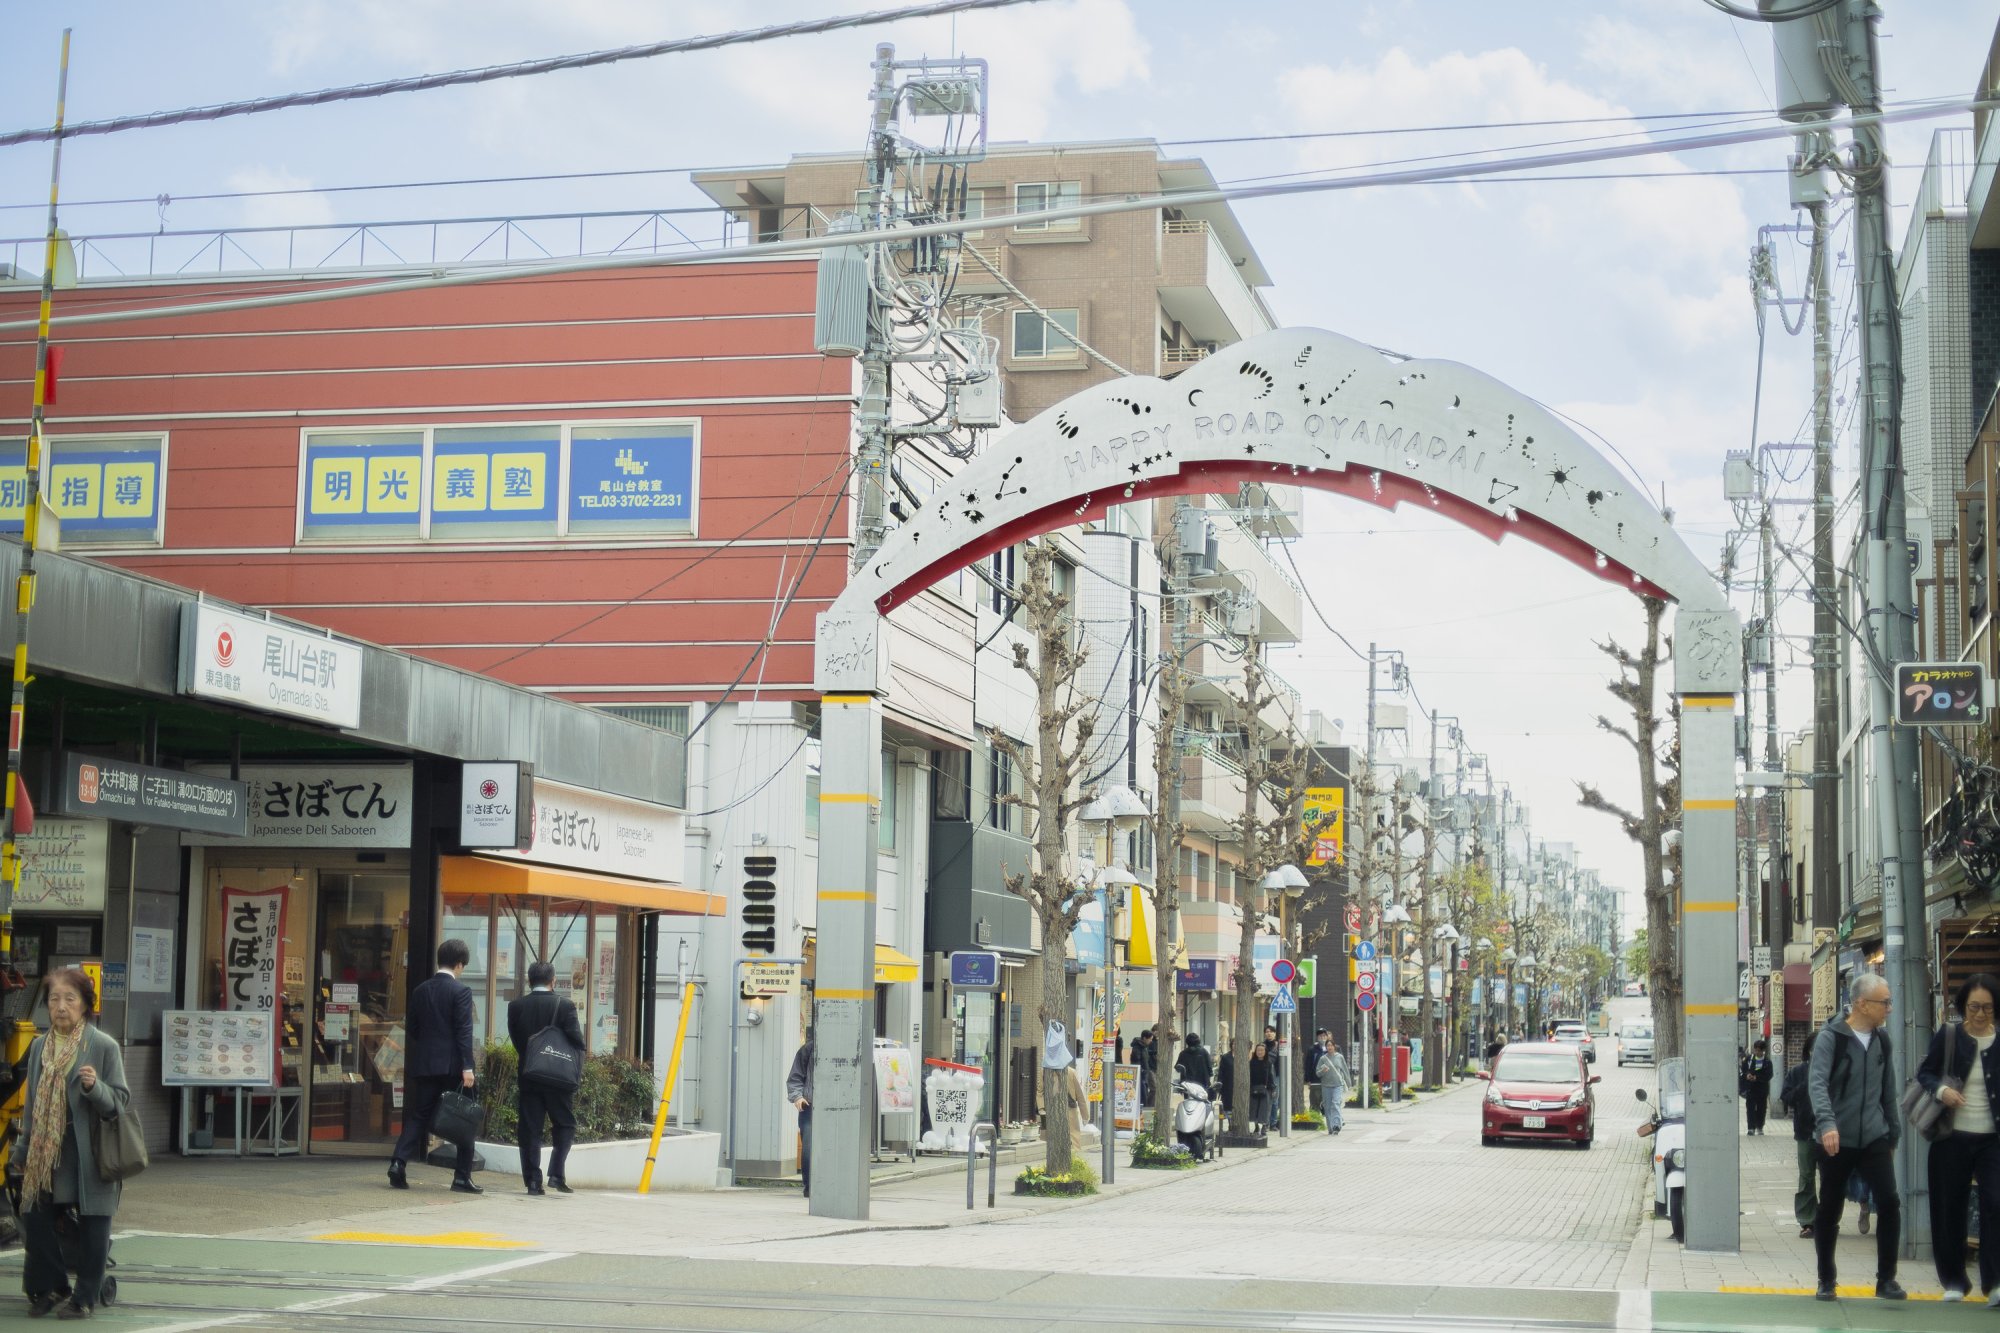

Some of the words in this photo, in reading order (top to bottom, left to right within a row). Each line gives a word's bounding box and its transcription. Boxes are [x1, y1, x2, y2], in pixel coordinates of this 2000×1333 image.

[1063, 423, 1173, 478] HAPPY
[1194, 411, 1285, 439] ROAD
[1305, 413, 1487, 474] OYAMADAI
[325, 467, 533, 501] 明光義塾
[600, 480, 662, 492] 尾山台教室
[579, 494, 682, 508] TEL03-3702-2231
[262, 634, 337, 689] 尾山台駅
[205, 669, 241, 692] 東急電鉄
[1912, 671, 1975, 682] カラオケサロン
[269, 682, 313, 707] Oyamadai
[314, 692, 331, 712] Sta.
[1905, 684, 1977, 713] アロン
[83, 770, 95, 782] OM
[100, 768, 139, 792] 大井町線
[123, 795, 136, 806] Line
[264, 779, 397, 819] さぼてん
[474, 803, 512, 815] さぼてん
[253, 824, 302, 837] Japanese
[306, 824, 327, 835] Deli
[331, 824, 376, 836] Saboten
[551, 808, 600, 853] さぼてん
[616, 822, 642, 842] Japanese
[623, 841, 647, 859] Saboten
[228, 902, 263, 1011] さぼて
[1361, 977, 1372, 986] 30
